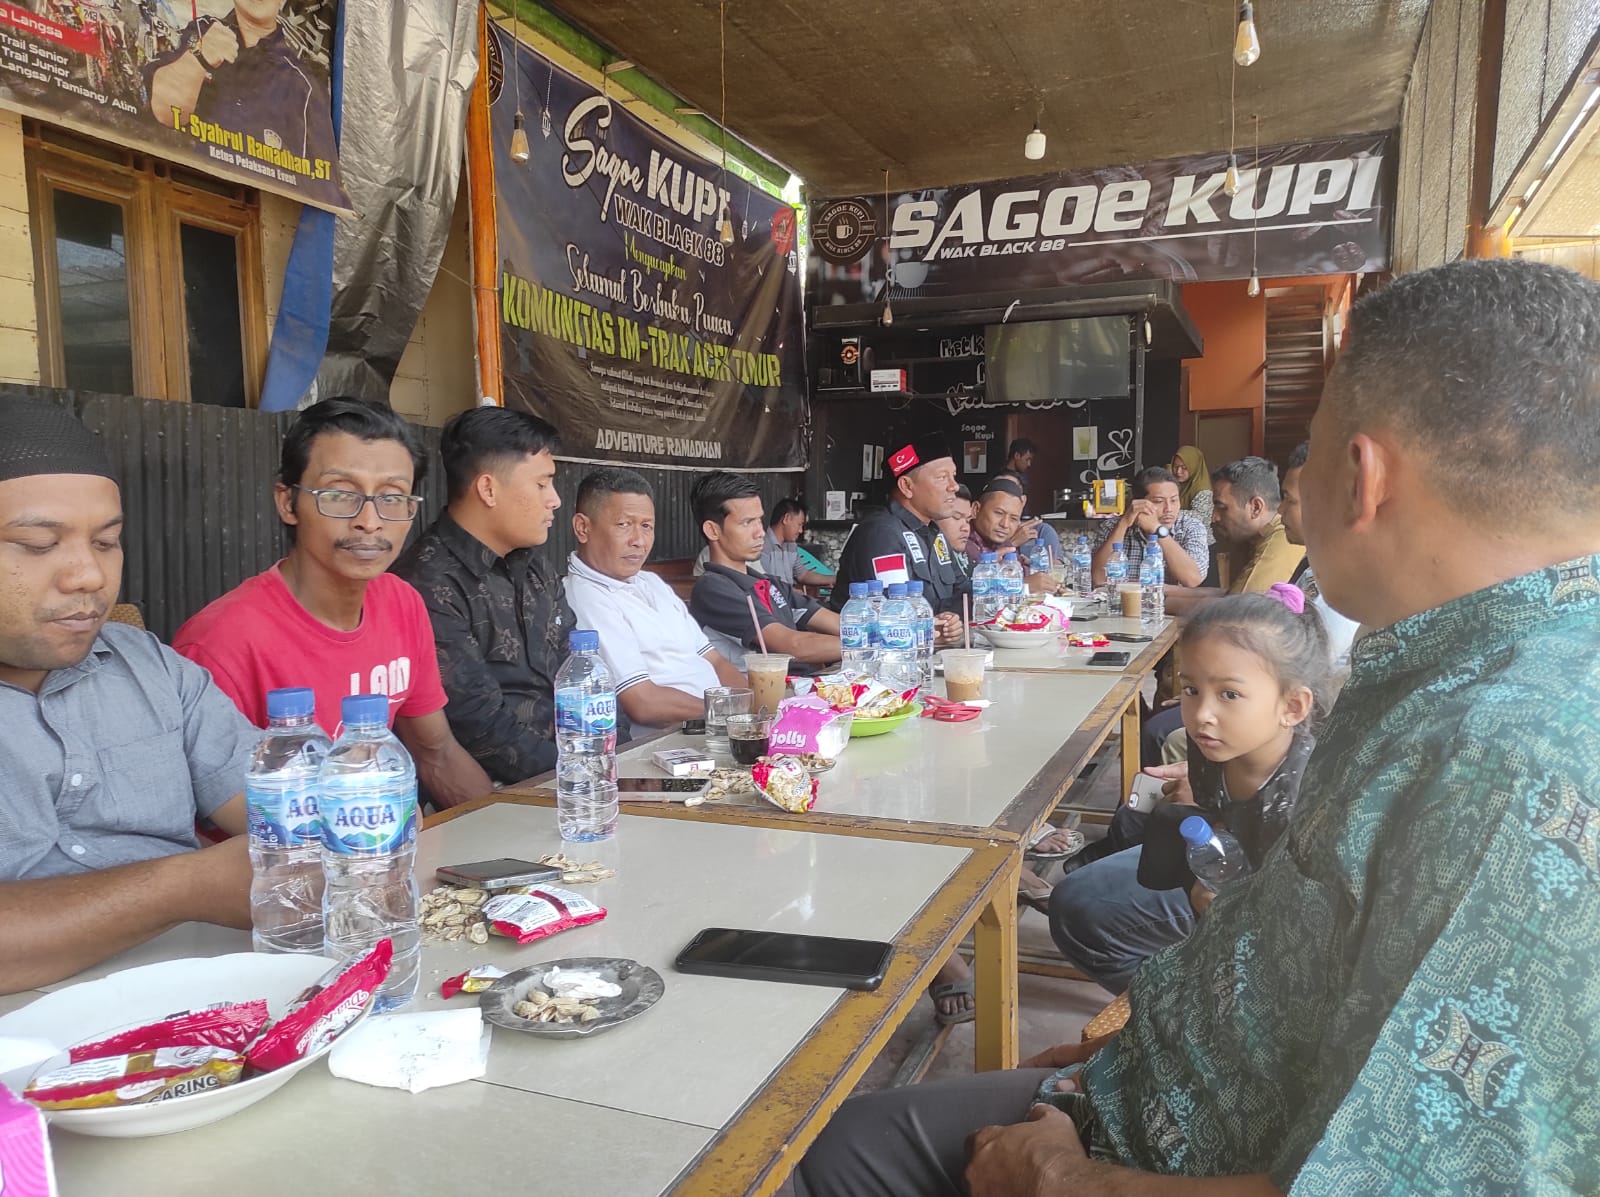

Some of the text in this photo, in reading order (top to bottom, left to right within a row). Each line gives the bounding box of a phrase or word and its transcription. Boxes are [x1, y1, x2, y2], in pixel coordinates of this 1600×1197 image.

[11, 9, 64, 40] Langsa
[0, 33, 70, 66] Trail Senior
[1, 45, 71, 78] Trail Junior
[170, 105, 187, 134] T.
[189, 114, 244, 153] Syahrul
[209, 145, 235, 164] Ketua
[235, 154, 276, 179] Pelaksana
[561, 95, 731, 232] Sagoe KUPI
[1163, 155, 1385, 228] KUPI
[614, 193, 725, 267] WAK BLACK 88
[940, 246, 978, 260] WAK
[979, 241, 1036, 258] BLACK
[566, 242, 735, 337] Selamat Berbuka Puasa
[502, 271, 616, 356] KOMUNITAS
[731, 349, 783, 388] TIMUR
[595, 428, 723, 460] ADVENTURE RAMADHAN
[770, 729, 807, 749] jolly
[335, 803, 397, 830] AQUA
